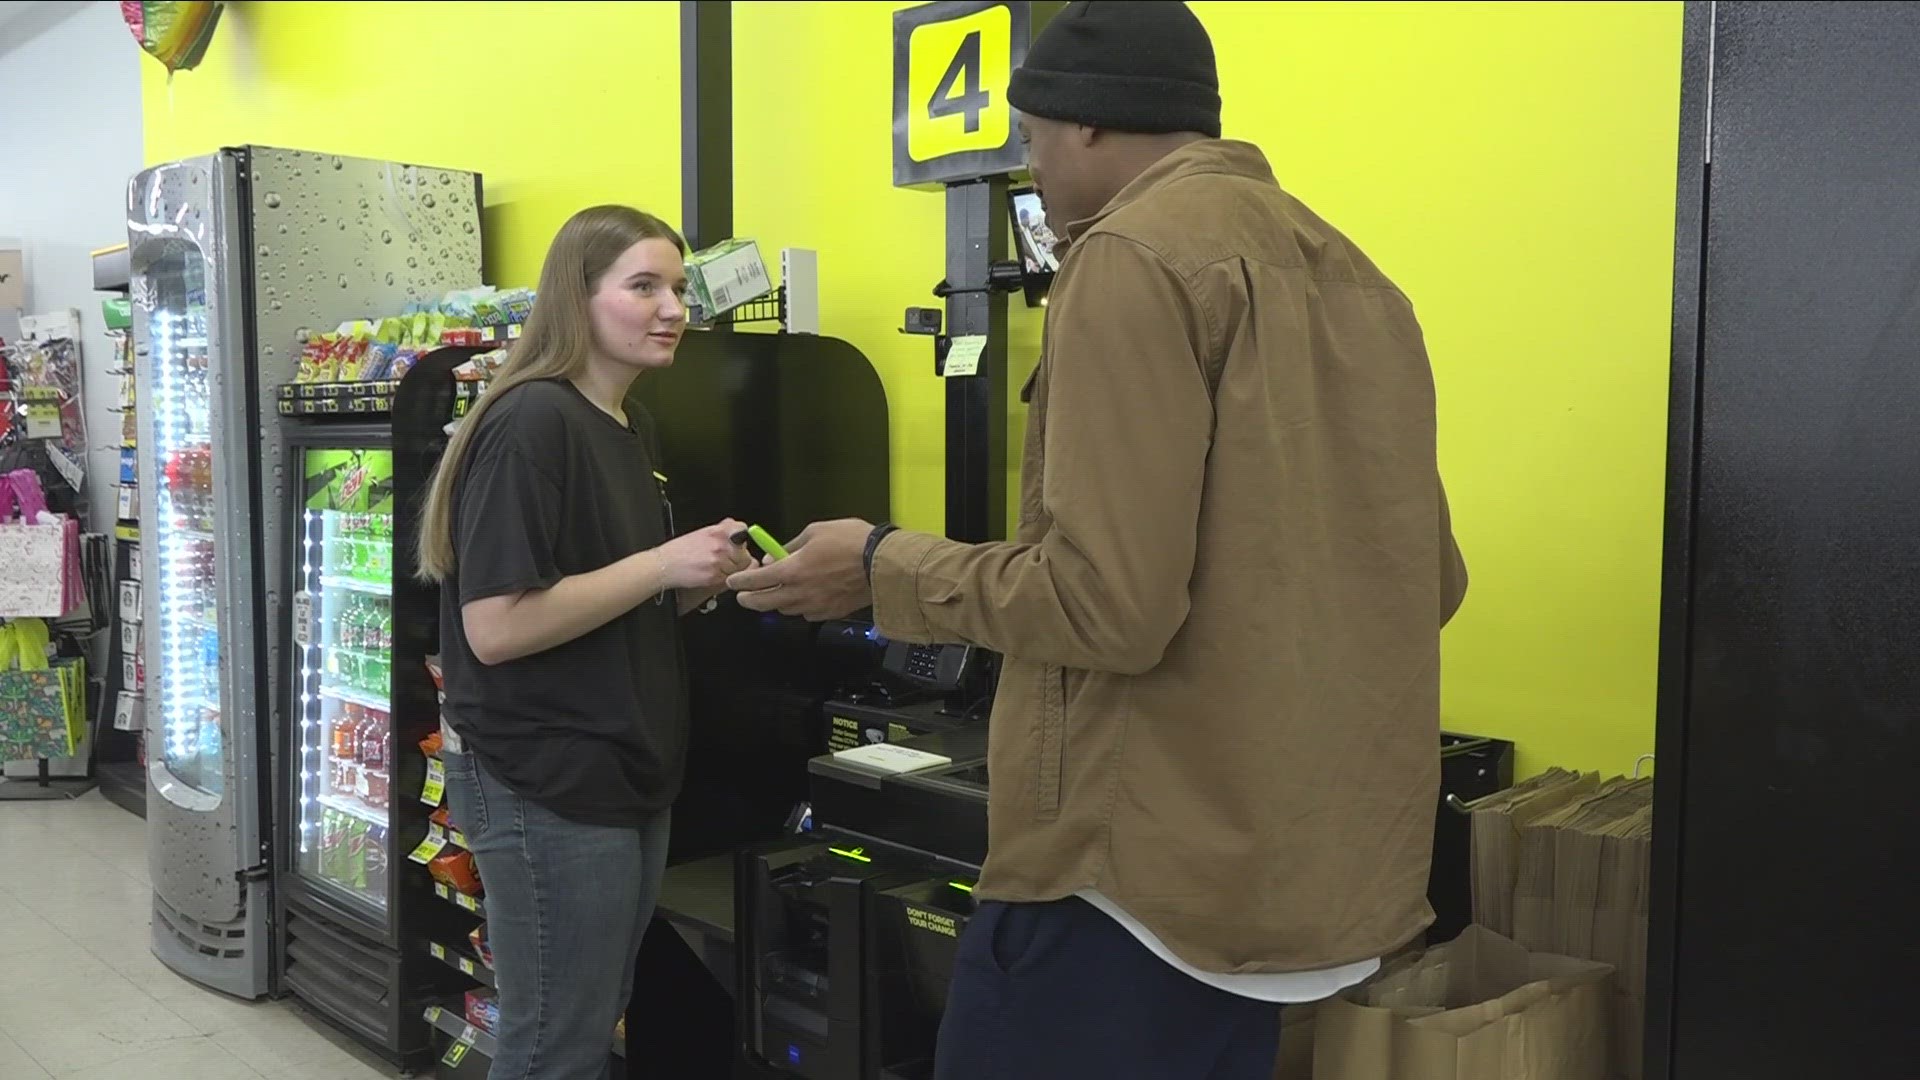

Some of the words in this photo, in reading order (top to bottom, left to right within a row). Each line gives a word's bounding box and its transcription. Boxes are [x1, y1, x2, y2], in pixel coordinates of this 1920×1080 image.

[927, 30, 990, 134] 4
[833, 716, 858, 731] NOTICE
[906, 906, 927, 920] DON'T
[928, 912, 955, 928] FORGET
[908, 916, 928, 928] YOUR
[928, 921, 957, 937] CHANGE
